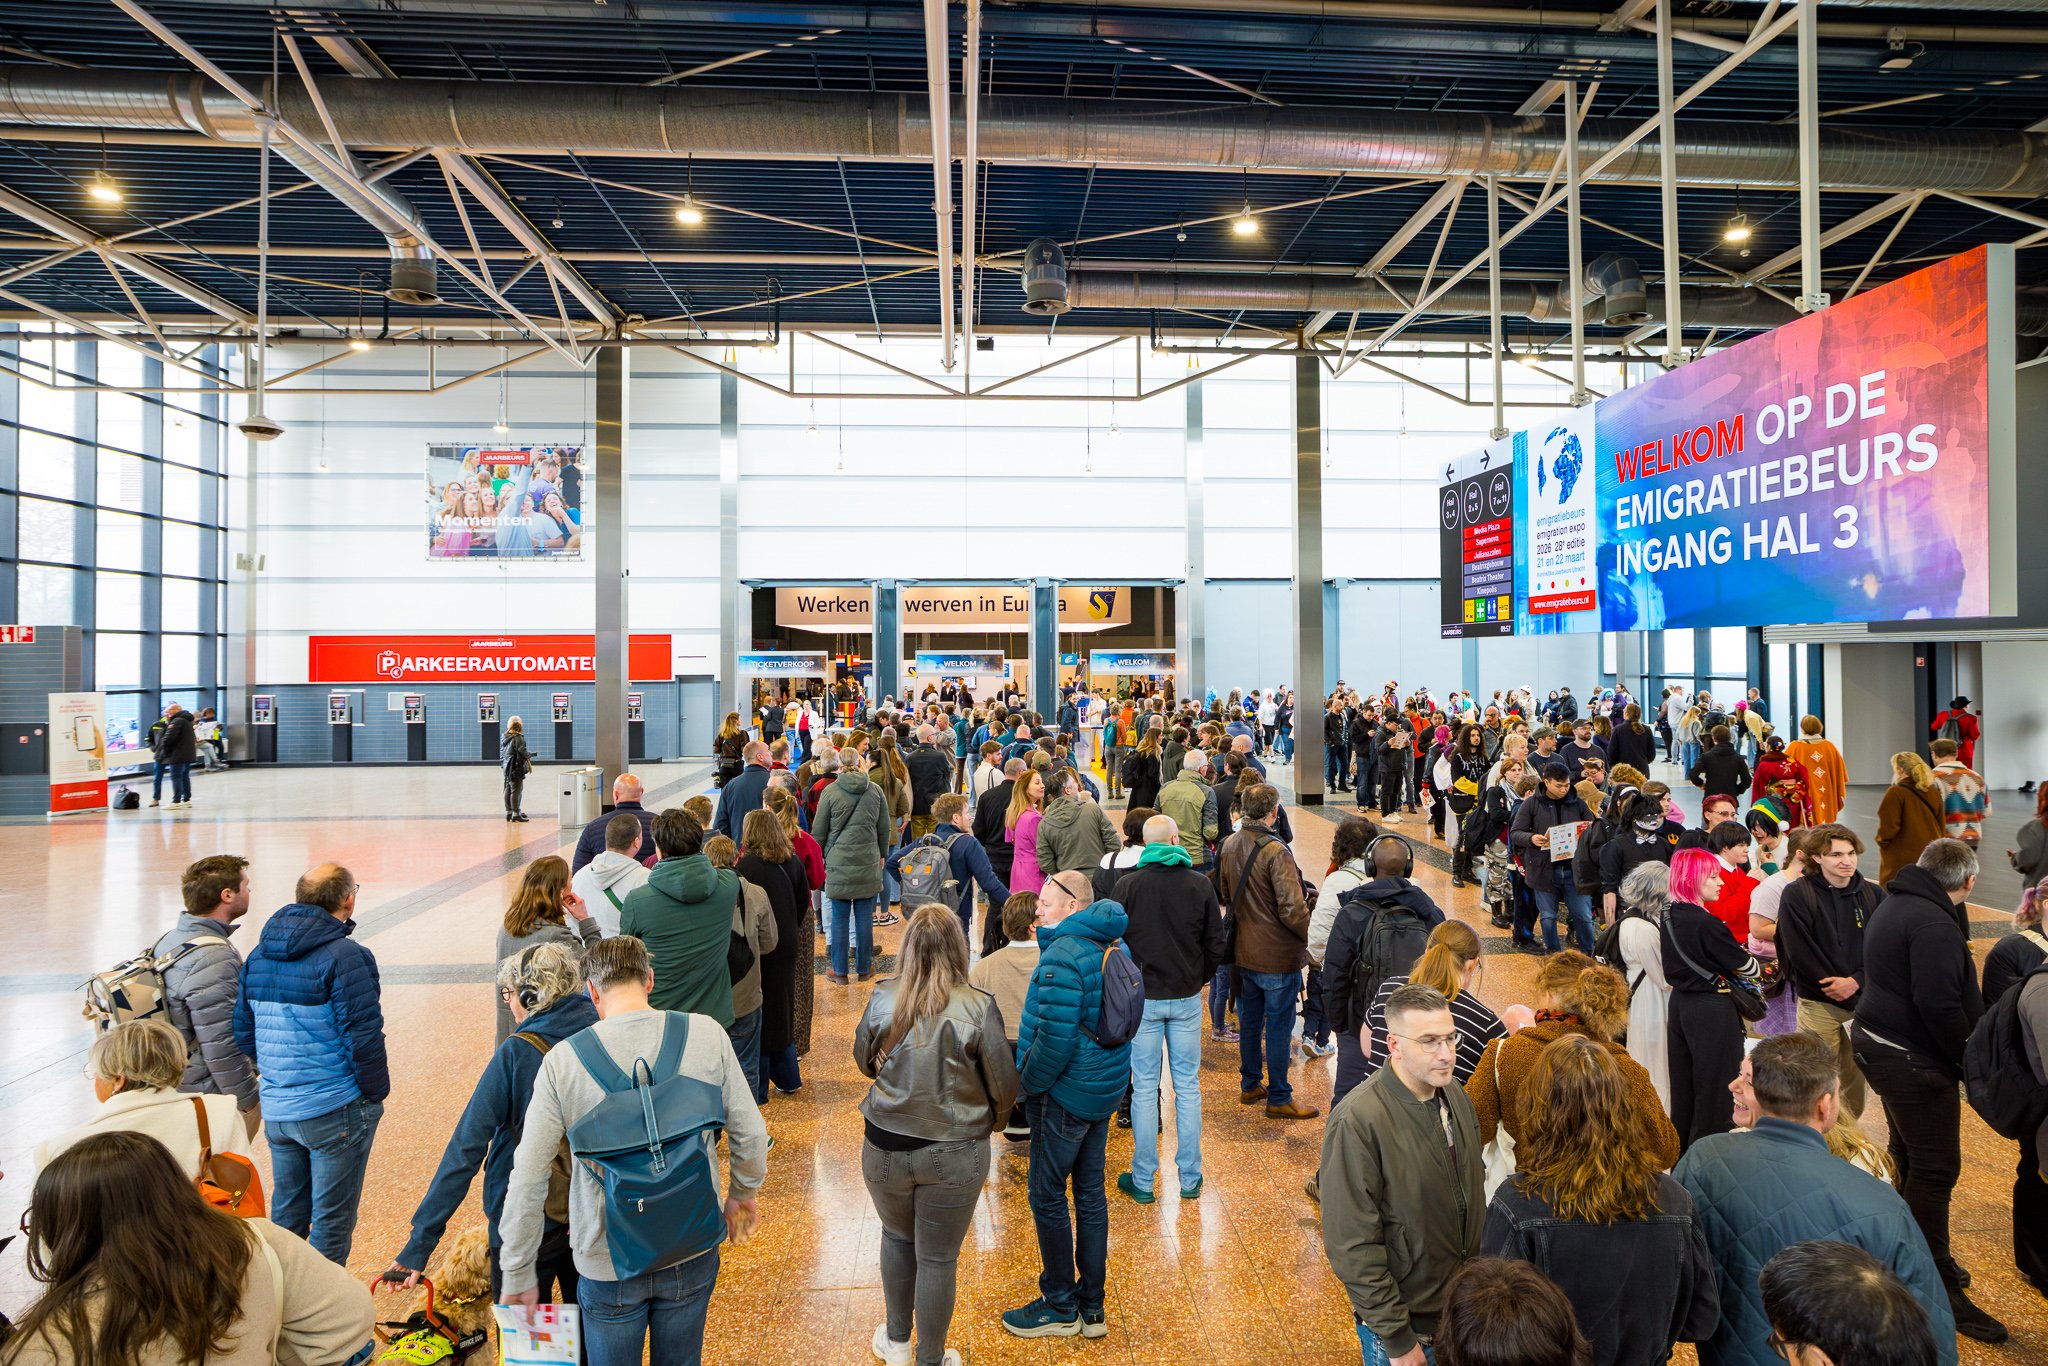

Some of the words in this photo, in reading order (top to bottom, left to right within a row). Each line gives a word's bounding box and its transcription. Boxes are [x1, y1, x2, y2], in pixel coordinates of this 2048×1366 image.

[1615, 413, 1744, 483] WELKOM
[1755, 394, 1812, 445] OP
[1825, 369, 1886, 429] DE
[1616, 423, 1938, 530] EMIGRATIEBEURS
[1495, 481, 1504, 491] Hal
[1469, 490, 1477, 499] Hal
[1446, 498, 1454, 506] Hal
[434, 513, 533, 527] Momenten
[1536, 508, 1586, 527] emigratiebeurs
[1474, 526, 1487, 535] Media
[1488, 523, 1500, 531] Plaza
[1536, 526, 1568, 540] emigration
[1569, 522, 1586, 534] expo
[1476, 535, 1499, 546] Supernova
[1536, 543, 1552, 555] 2026
[1566, 537, 1586, 550] editie
[1616, 526, 1732, 576] INGANG
[1743, 512, 1820, 561] HAL
[1832, 504, 1859, 550] 3
[1474, 548, 1501, 559] Julianazalen
[1536, 557, 1544, 568] 21
[1545, 557, 1554, 566] en
[1555, 553, 1564, 565] 22
[1565, 550, 1586, 563] maart
[1472, 560, 1504, 571] Beatrixgebouw
[1472, 575, 1487, 583] Beatrix
[1487, 573, 1504, 581] Theater
[1476, 586, 1498, 595] Kinepolis
[797, 596, 869, 613] Werken
[905, 599, 973, 612] werven
[979, 596, 995, 612] in
[1003, 596, 1067, 612] Eura
[1534, 595, 1590, 609] www.emigratiebeurs.nl
[1442, 628, 1462, 636] JAARBEURS
[1118, 658, 1150, 666] WELKOM
[460, 1338, 474, 1348] SERVICE
[475, 1335, 483, 1343] DOG
